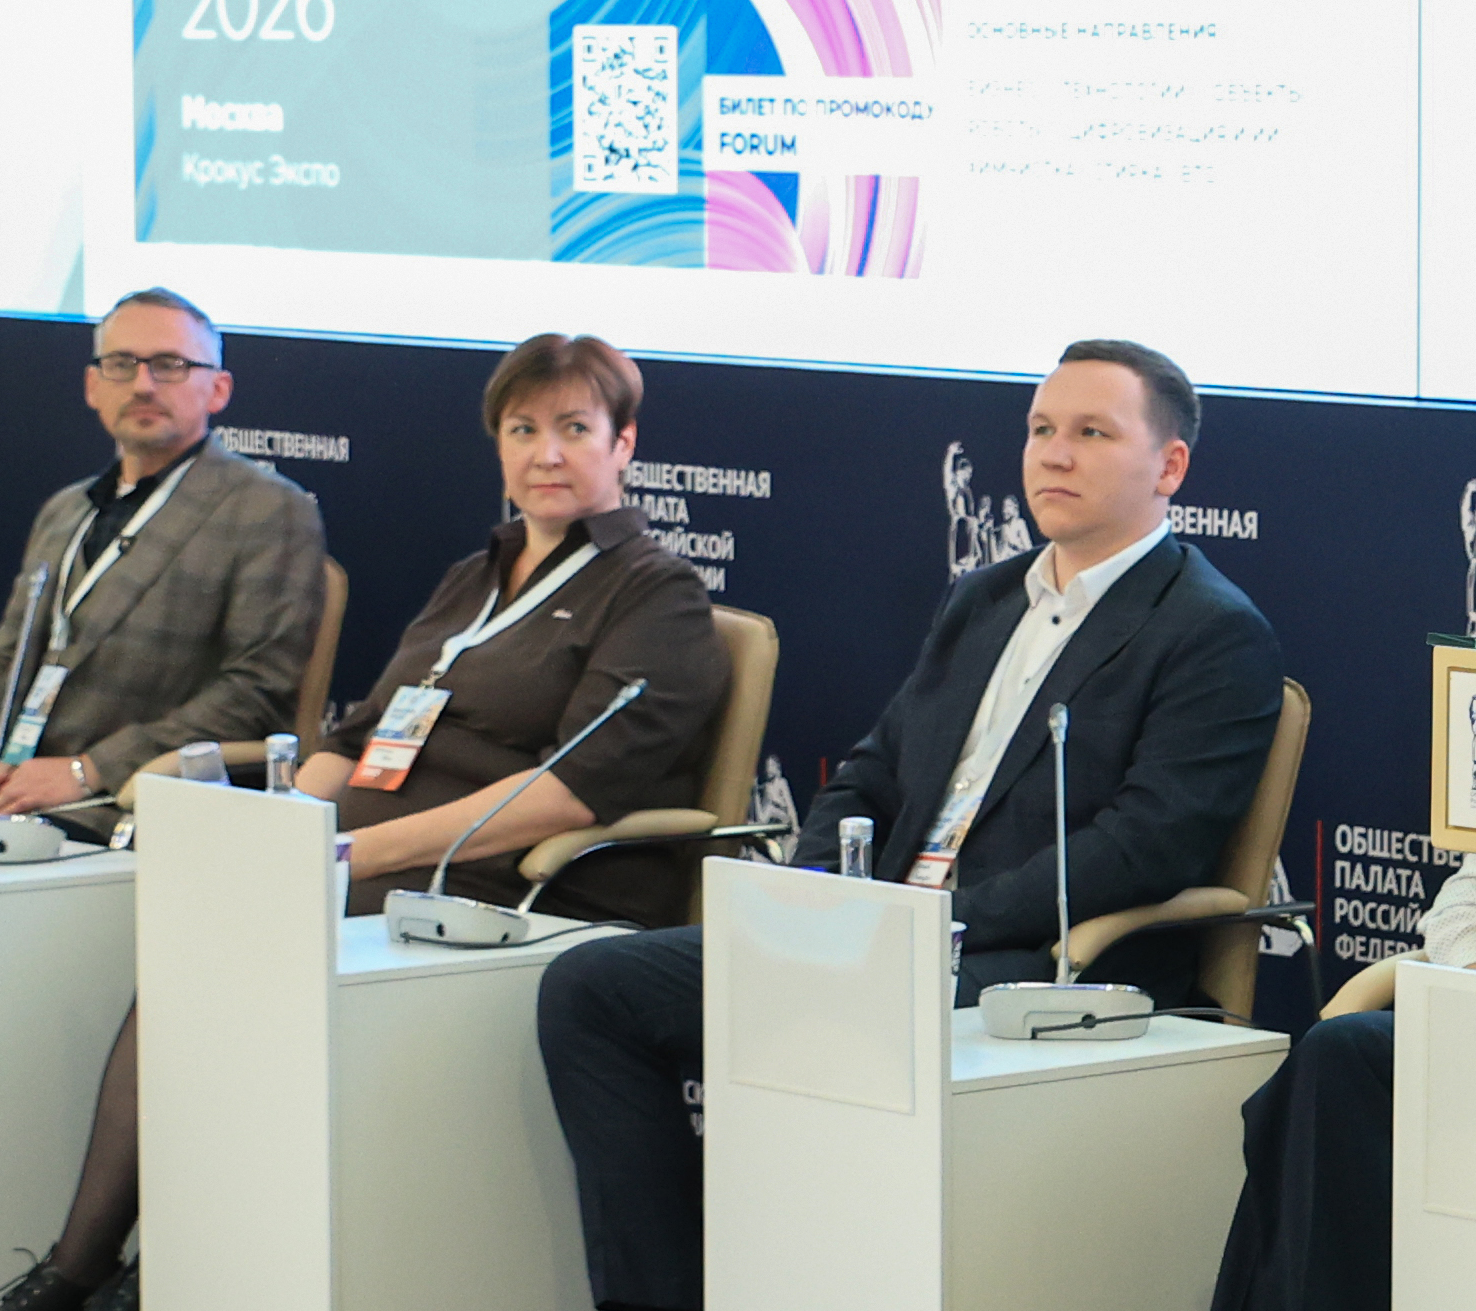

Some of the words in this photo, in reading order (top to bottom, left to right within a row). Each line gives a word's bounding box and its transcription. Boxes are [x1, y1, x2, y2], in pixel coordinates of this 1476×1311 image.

[181, 94, 284, 132] Москва
[718, 96, 776, 117] БИЛЕТ
[815, 98, 934, 121] ПРОМОКОДУ
[718, 131, 798, 156] FORUM
[182, 152, 264, 189] Крокус
[268, 154, 340, 187] Экспо
[1171, 505, 1259, 540] ВЕННАЯ
[1334, 824, 1461, 867] ОБЩЕСТВЕ
[1334, 859, 1426, 899] ПАЛАТА
[1334, 897, 1422, 934] РОССИЙ
